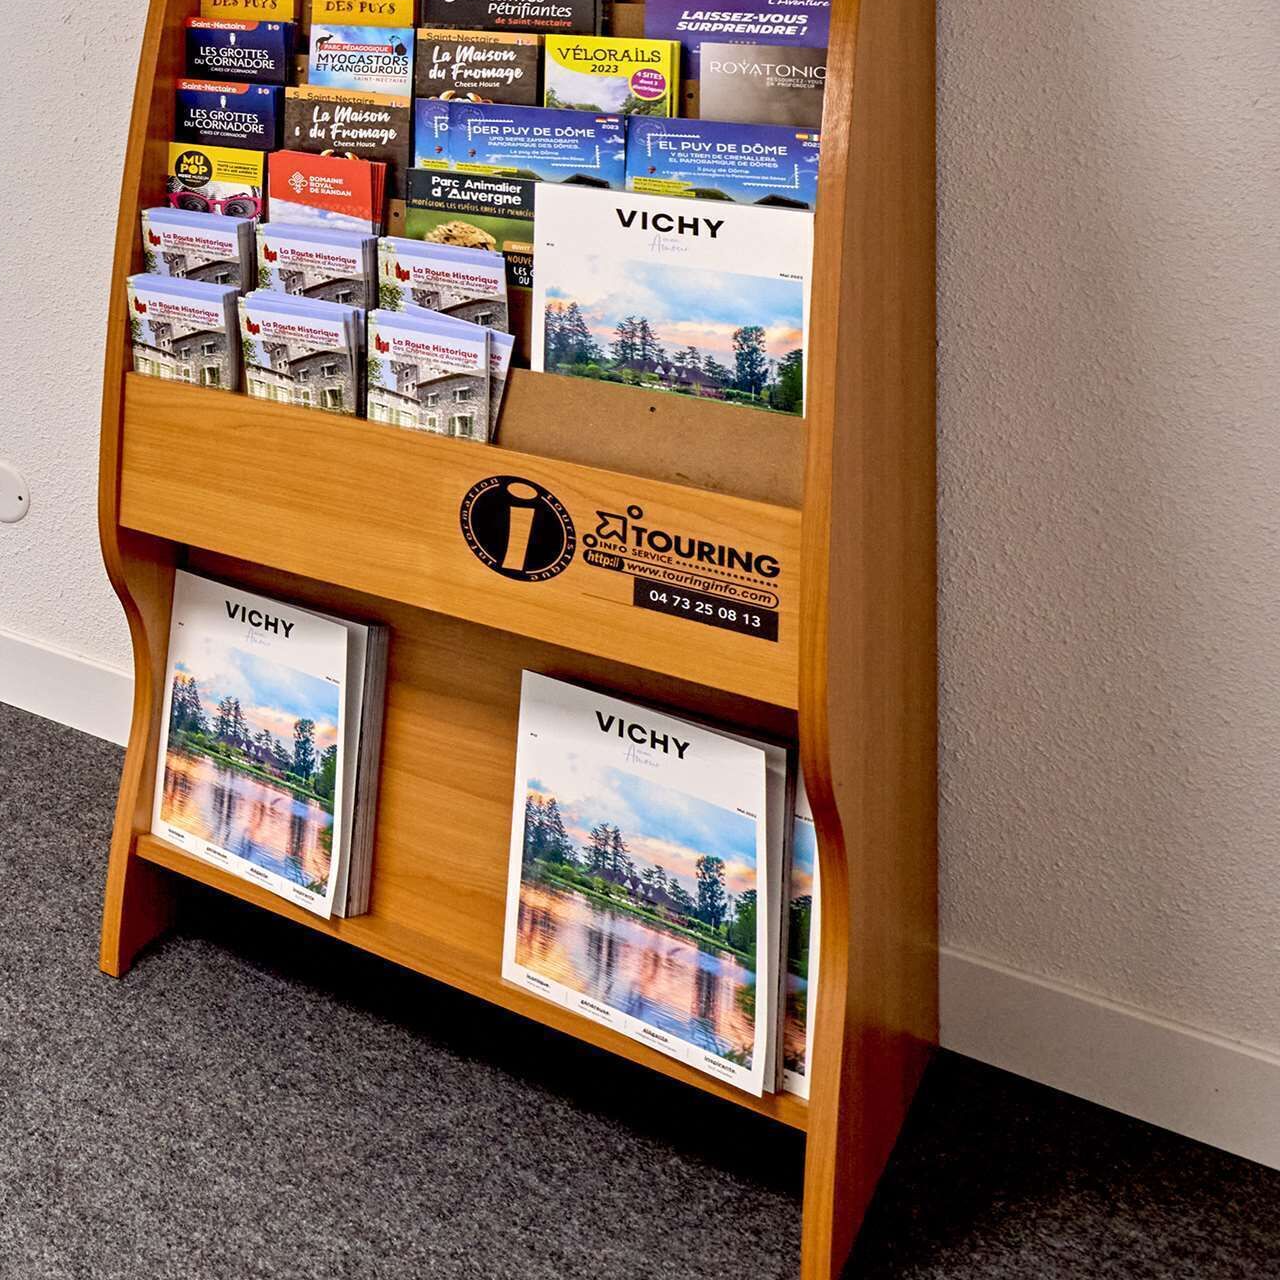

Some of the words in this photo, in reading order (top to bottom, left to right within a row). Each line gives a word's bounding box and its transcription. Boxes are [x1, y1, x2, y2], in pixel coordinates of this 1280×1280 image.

[488, 2, 572, 18] Pétrifiantes
[681, 10, 808, 24] LAISSEZ-VOUS
[191, 20, 247, 31] Saint-Nectaire
[495, 17, 506, 25] de
[508, 17, 572, 27] Saint-Nectaire
[676, 21, 797, 35] SURPRENDRE
[200, 46, 217, 57] LES
[219, 48, 269, 60] GROTTES
[317, 53, 409, 66] MYOCASTORS
[432, 46, 451, 63] La
[456, 45, 516, 63] Maison
[206, 56, 276, 70] CORNADORE
[316, 64, 328, 72] ET
[331, 64, 409, 75] KANGOUROUS
[591, 64, 618, 73] 2023
[429, 65, 446, 80] du
[451, 63, 523, 85] Fromage
[454, 80, 477, 88] Cheese
[473, 126, 499, 136] DER
[503, 127, 529, 137] PUY
[533, 128, 552, 137] DE
[556, 126, 595, 138] DÔME
[659, 141, 677, 151] EL
[681, 142, 714, 153] PUY
[716, 143, 737, 154] DE
[741, 143, 788, 156] DÔME
[183, 154, 204, 166] MU
[180, 163, 209, 176] POP
[309, 176, 344, 185] DOMAINE
[309, 182, 333, 190] ROYAL
[431, 176, 459, 188] Parc
[465, 179, 522, 195] Animalier
[321, 188, 352, 197] RANDAN
[616, 208, 725, 239] VICHY
[412, 266, 424, 275] La
[425, 268, 451, 279] Route
[452, 270, 500, 286] Historique
[599, 541, 628, 554] INFO
[631, 548, 674, 566] SERVICE
[631, 525, 780, 579] TOURING
[627, 561, 772, 606] www.touringinfo.com
[649, 589, 668, 605] 04
[672, 595, 690, 610] 73
[695, 600, 713, 616] 25
[718, 606, 737, 622] 08
[742, 612, 761, 629] 13
[225, 600, 294, 639] VICHY
[595, 710, 690, 760] VICHY
